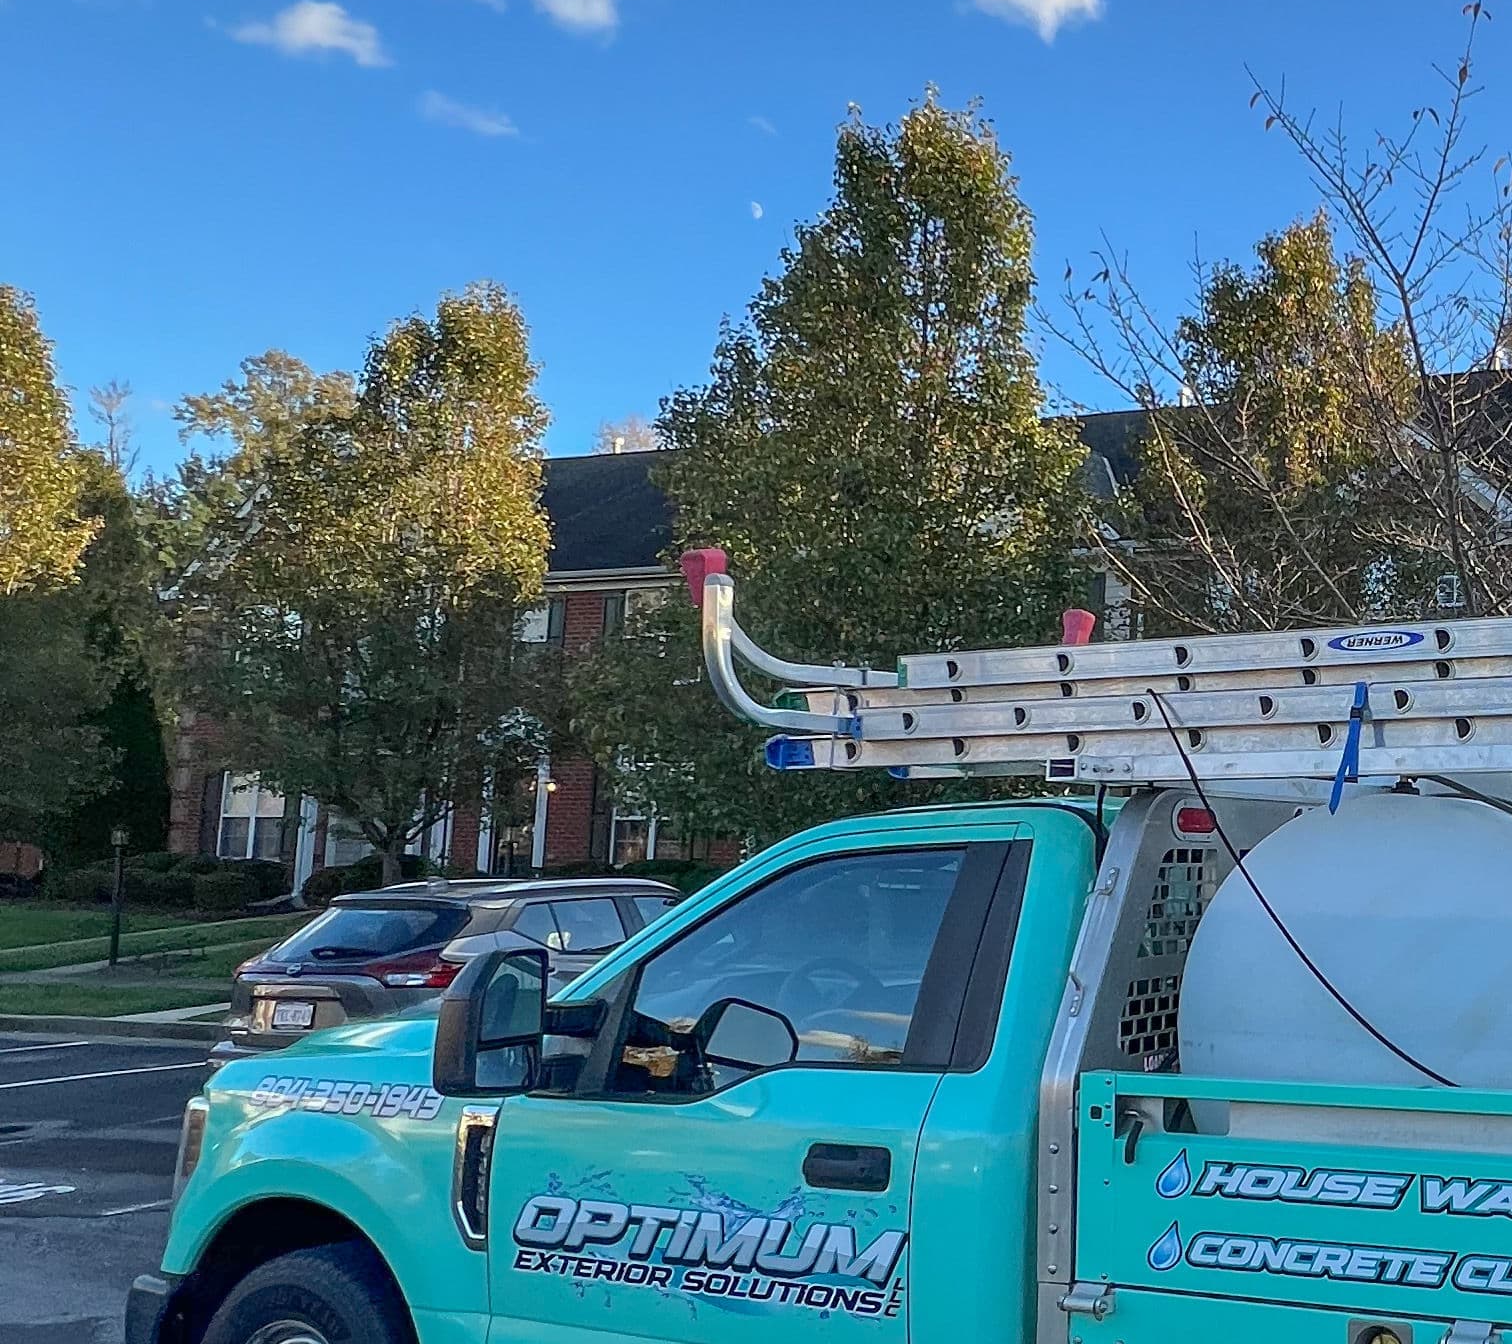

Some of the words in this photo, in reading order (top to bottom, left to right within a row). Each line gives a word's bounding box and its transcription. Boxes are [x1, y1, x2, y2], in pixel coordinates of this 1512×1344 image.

[1348, 634, 1403, 649] WERNER
[251, 1076, 445, 1119] 804-350-1943
[1195, 1161, 1411, 1208] HOUSE
[514, 1195, 908, 1288] OPTIMUM
[1187, 1233, 1456, 1287] CONCRETE
[514, 1249, 674, 1288] EXTERIOR
[681, 1270, 886, 1317] SOLUTIONS
